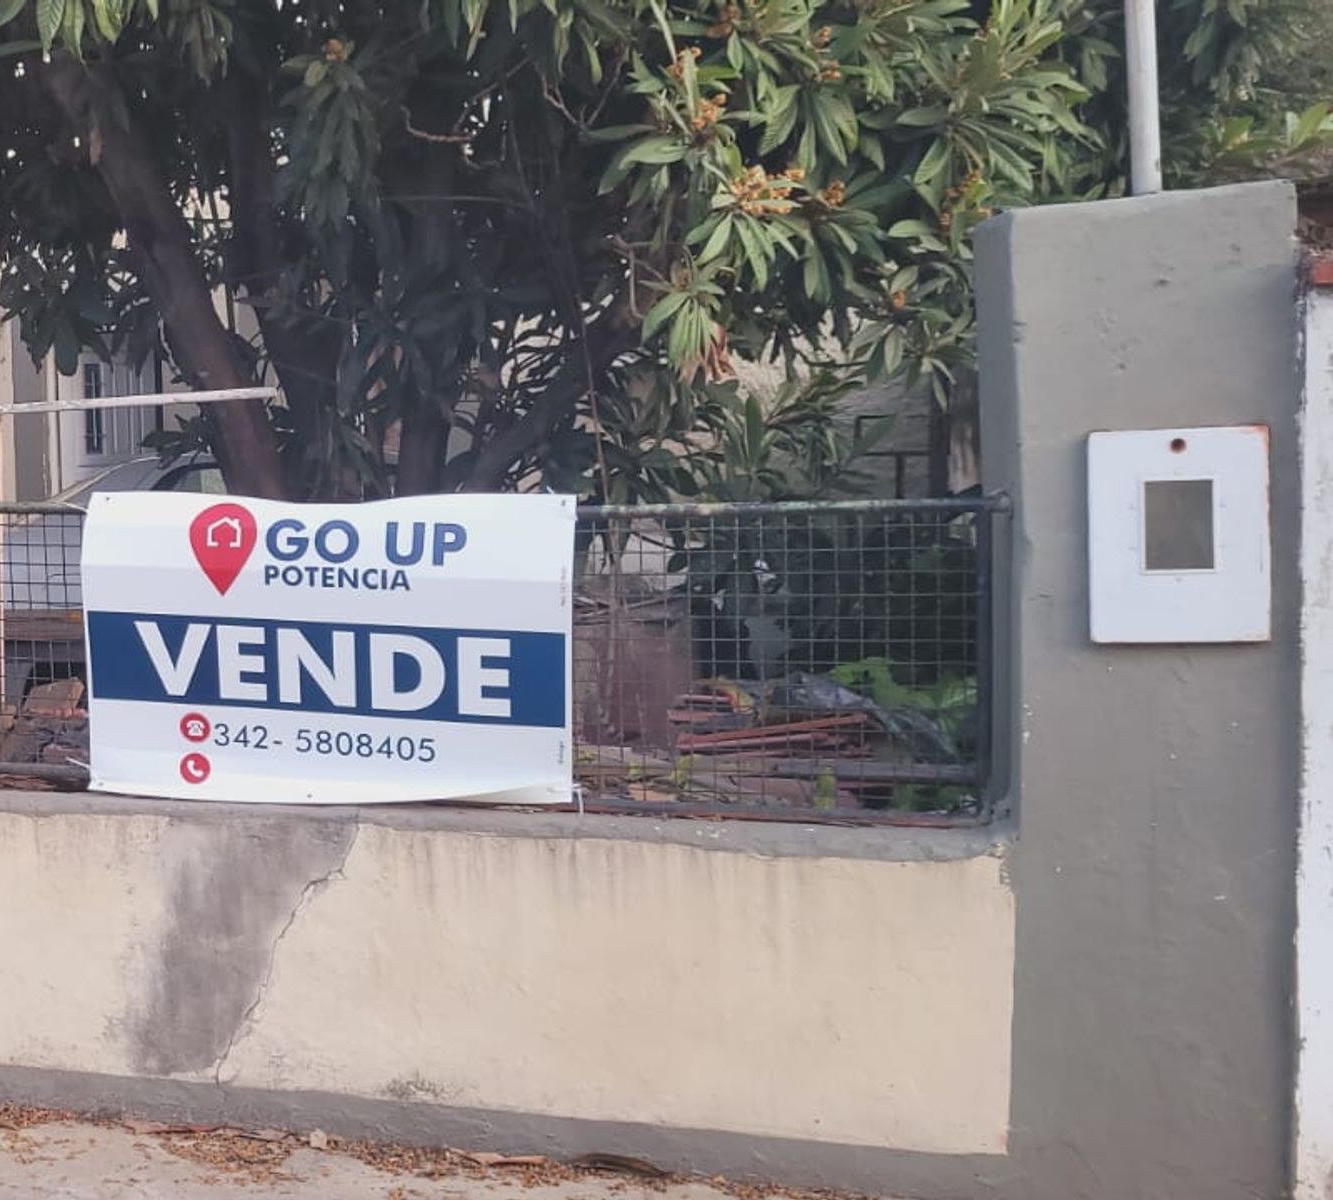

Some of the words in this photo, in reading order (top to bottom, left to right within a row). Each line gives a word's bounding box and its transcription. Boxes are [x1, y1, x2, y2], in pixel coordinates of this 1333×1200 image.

[265, 518, 360, 564] GO
[385, 521, 467, 567] UP
[264, 565, 411, 591] POTENCIA
[133, 619, 512, 718] VENDE
[213, 723, 283, 750] 342-
[296, 729, 436, 763] 5808405
